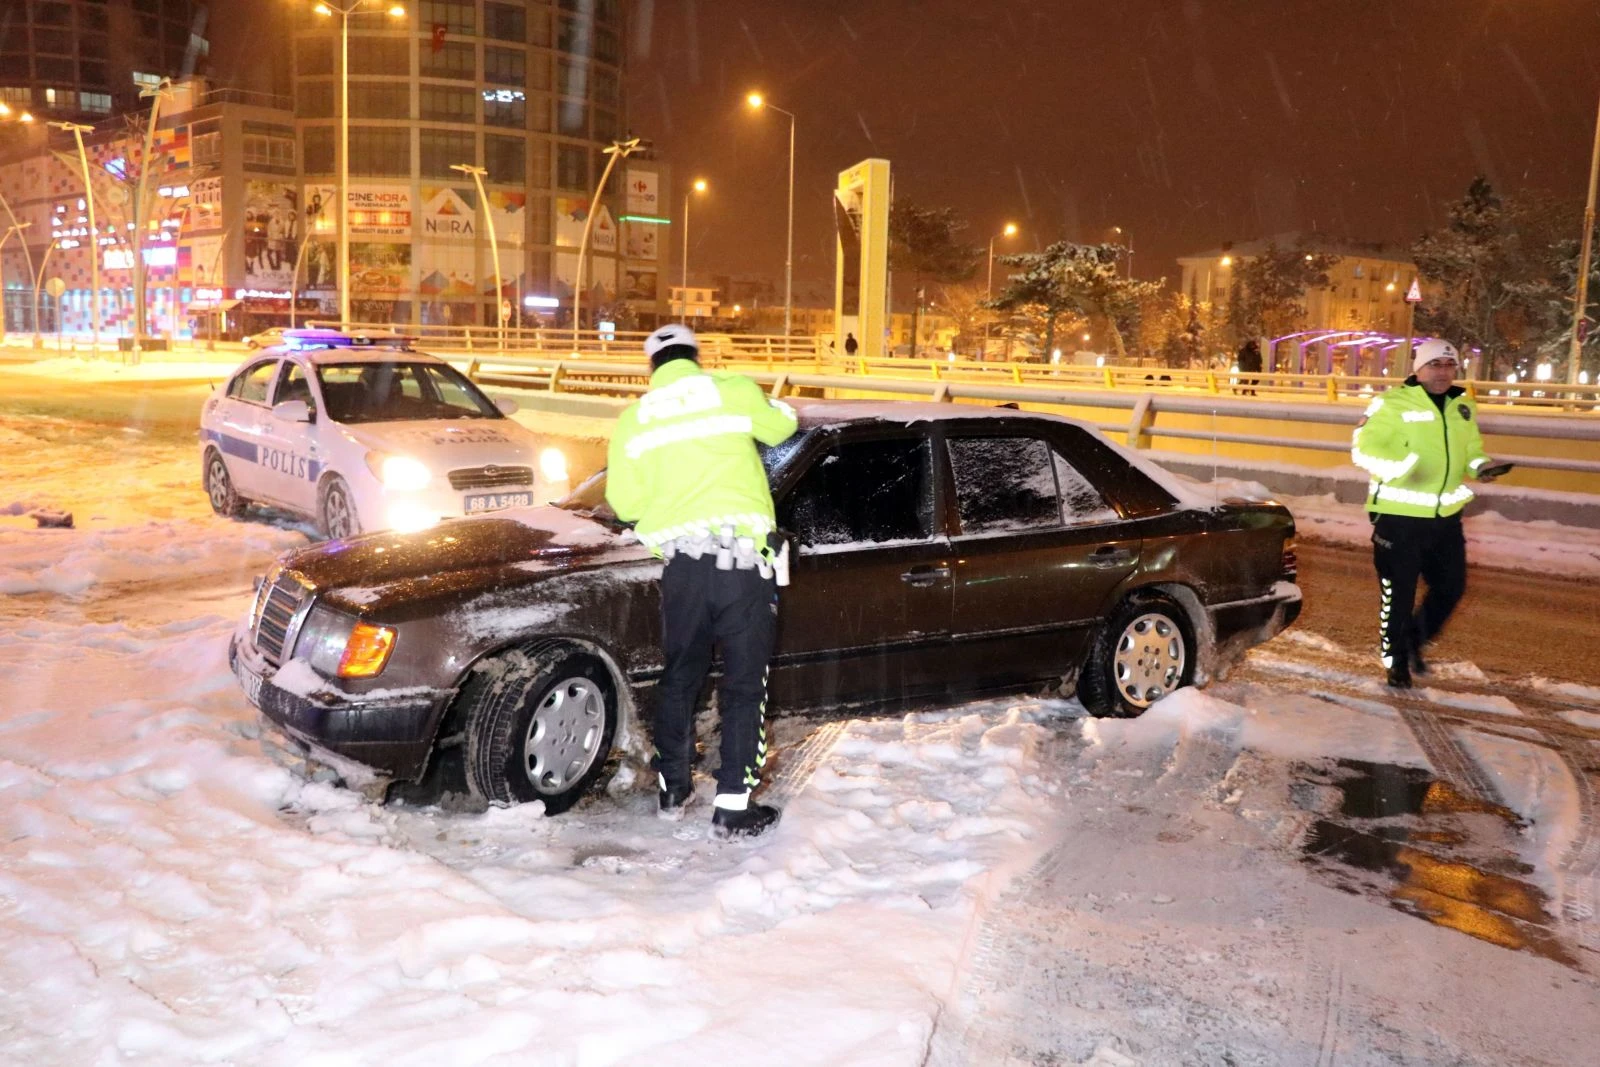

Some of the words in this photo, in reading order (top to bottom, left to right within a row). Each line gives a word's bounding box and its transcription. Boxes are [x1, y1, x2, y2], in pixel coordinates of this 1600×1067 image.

[426, 217, 474, 234] NORA
[262, 447, 305, 479] POLİS
[488, 496, 498, 509] A
